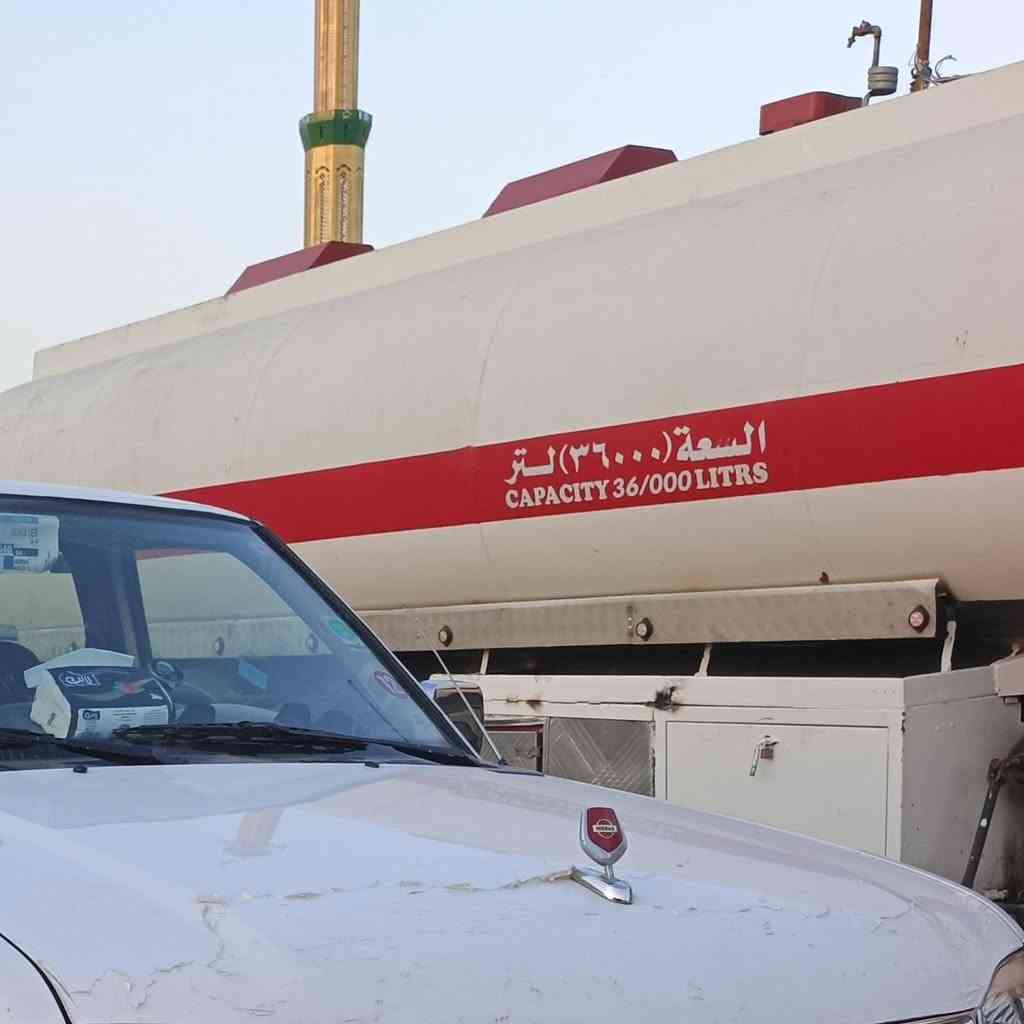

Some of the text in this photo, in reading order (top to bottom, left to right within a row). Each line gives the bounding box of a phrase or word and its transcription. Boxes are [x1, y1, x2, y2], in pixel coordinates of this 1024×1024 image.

[673, 420, 768, 462] السعة
[504, 462, 769, 509] CAPACITY 36/000 LITRS
